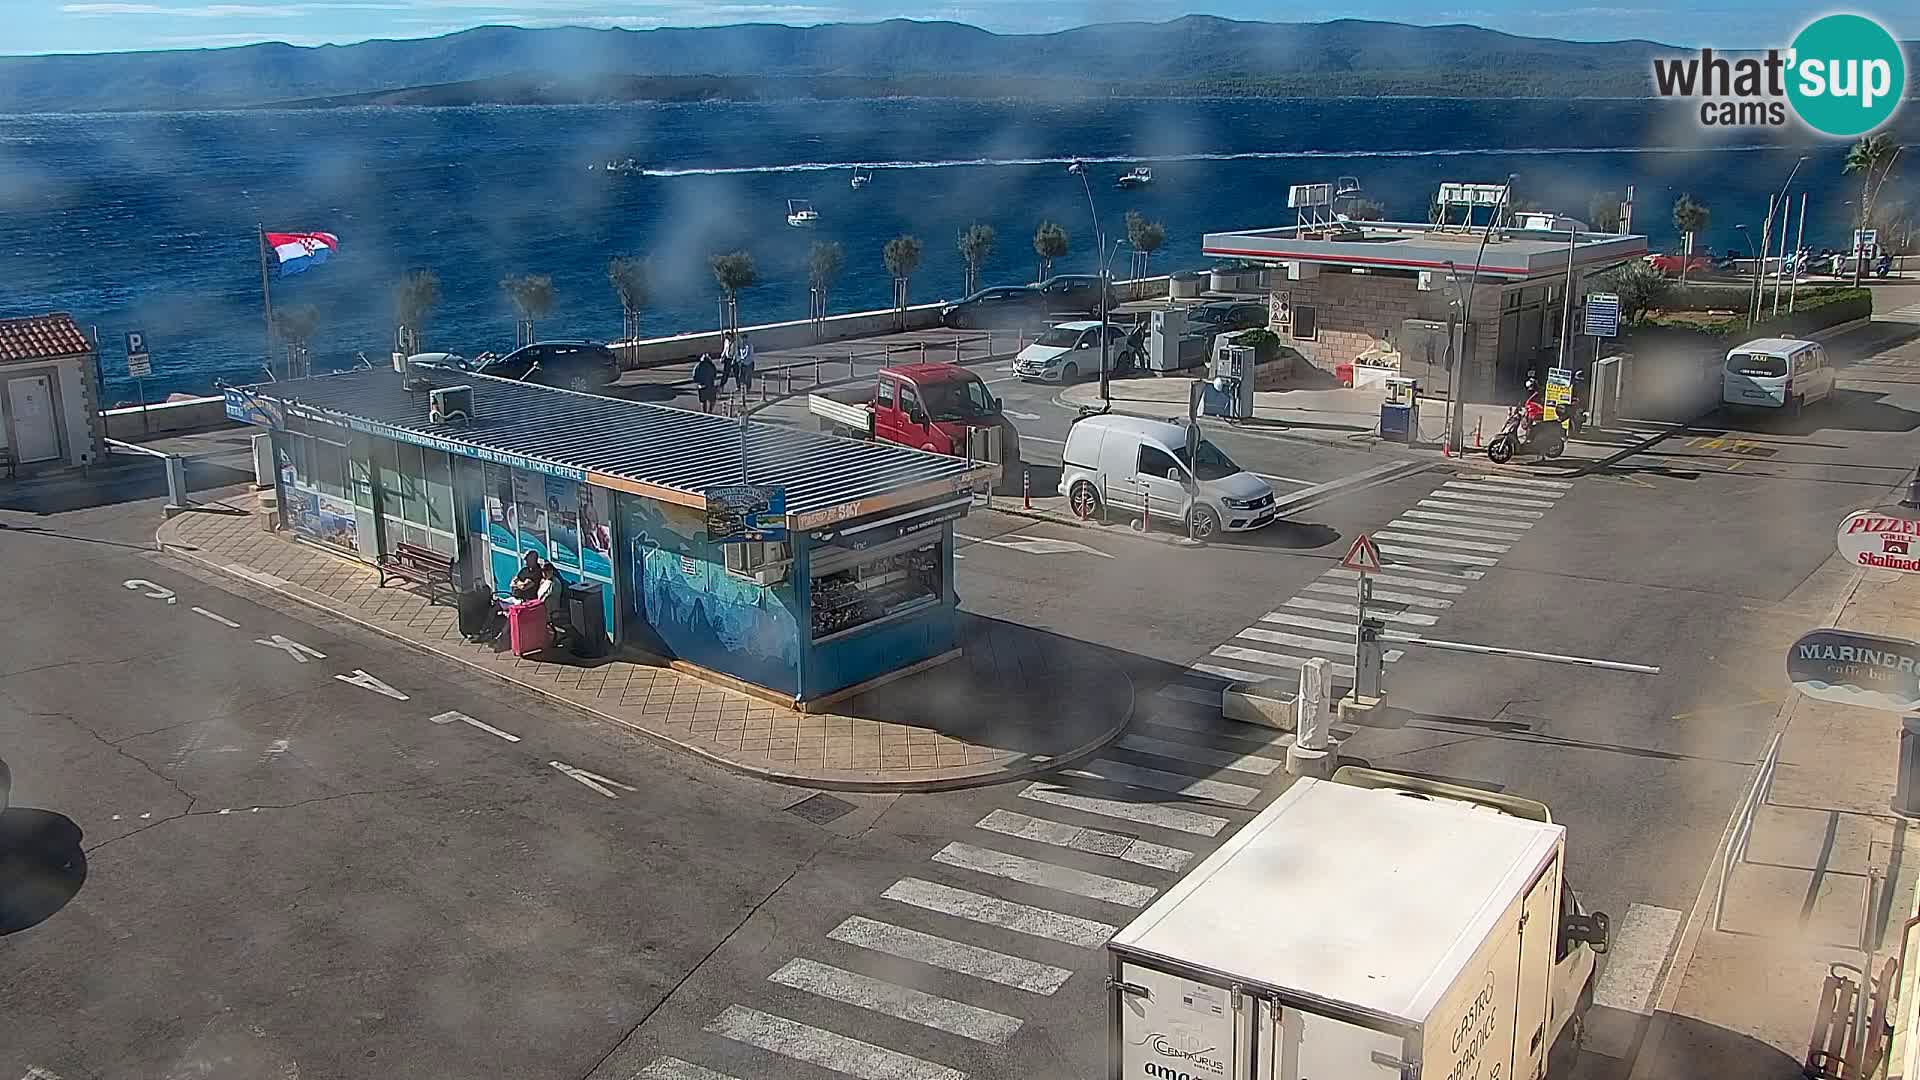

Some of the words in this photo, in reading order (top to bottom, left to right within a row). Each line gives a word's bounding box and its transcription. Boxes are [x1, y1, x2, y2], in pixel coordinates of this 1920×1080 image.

[130, 334, 142, 351] P
[1750, 354, 1767, 362] TAXI
[395, 430, 435, 447] AUTOBUSNA
[436, 438, 467, 455] POSTAJA
[477, 448, 493, 460] BUS
[494, 452, 526, 467] STATION
[528, 460, 554, 473] TICKET
[555, 466, 581, 480] OFFICE
[1847, 518, 1920, 537] PIZZE
[1880, 533, 1916, 543] GRILL
[1452, 984, 1494, 1053] GASTRO
